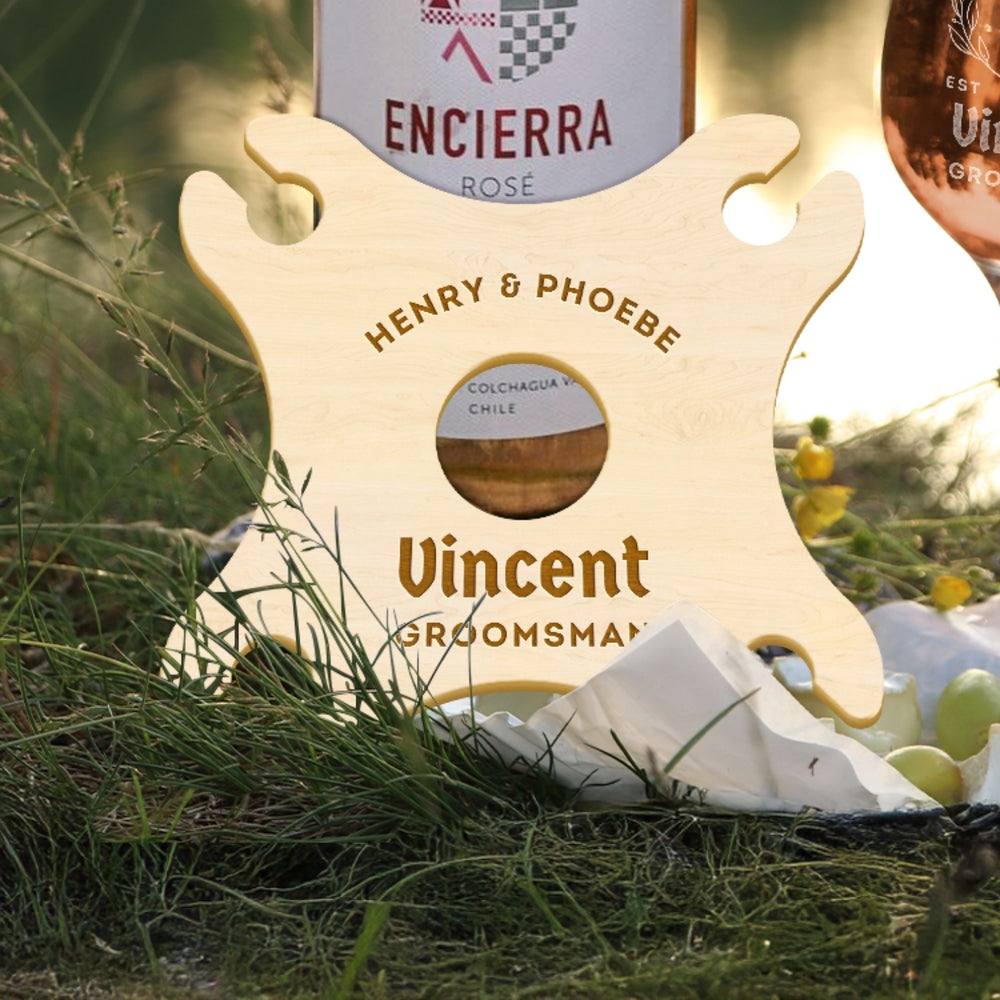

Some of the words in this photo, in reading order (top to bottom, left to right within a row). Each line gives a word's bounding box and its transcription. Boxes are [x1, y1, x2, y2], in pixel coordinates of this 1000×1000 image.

[946, 75, 981, 94] EST
[386, 98, 612, 159] ENCIERRA
[461, 171, 535, 198] ROSÉ
[364, 276, 484, 353] HENRY
[500, 273, 521, 298] &
[536, 273, 681, 354] PHOEBE
[467, 378, 558, 394] COLCHAGUA
[468, 403, 516, 415] CHILE
[399, 533, 651, 598] Vincent
